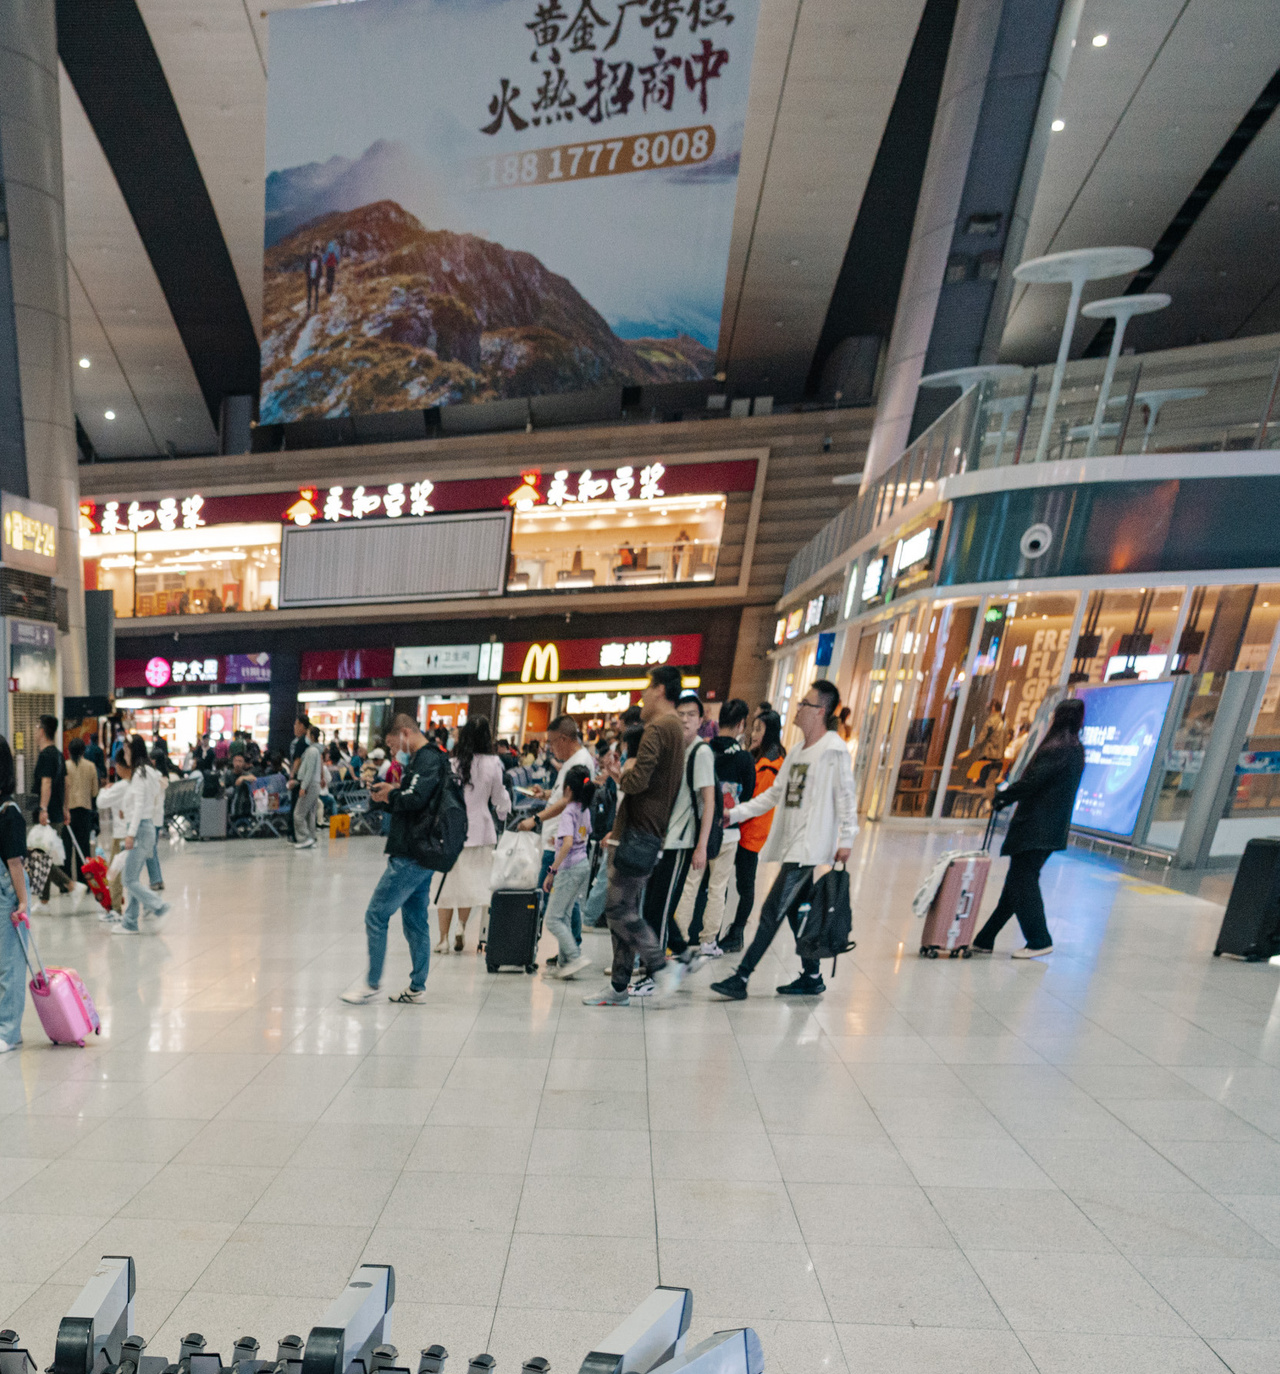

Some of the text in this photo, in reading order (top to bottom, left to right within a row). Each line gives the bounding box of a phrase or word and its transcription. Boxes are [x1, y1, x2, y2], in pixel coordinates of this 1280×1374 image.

[480, 38, 730, 135] 火热招商中
[486, 129, 710, 187] 188 1777 8008
[324, 480, 435, 522] 永和豆浆
[547, 463, 666, 507] 永和豆浆
[101, 494, 206, 534] 永和豆浆
[599, 640, 672, 667] 麦当劳
